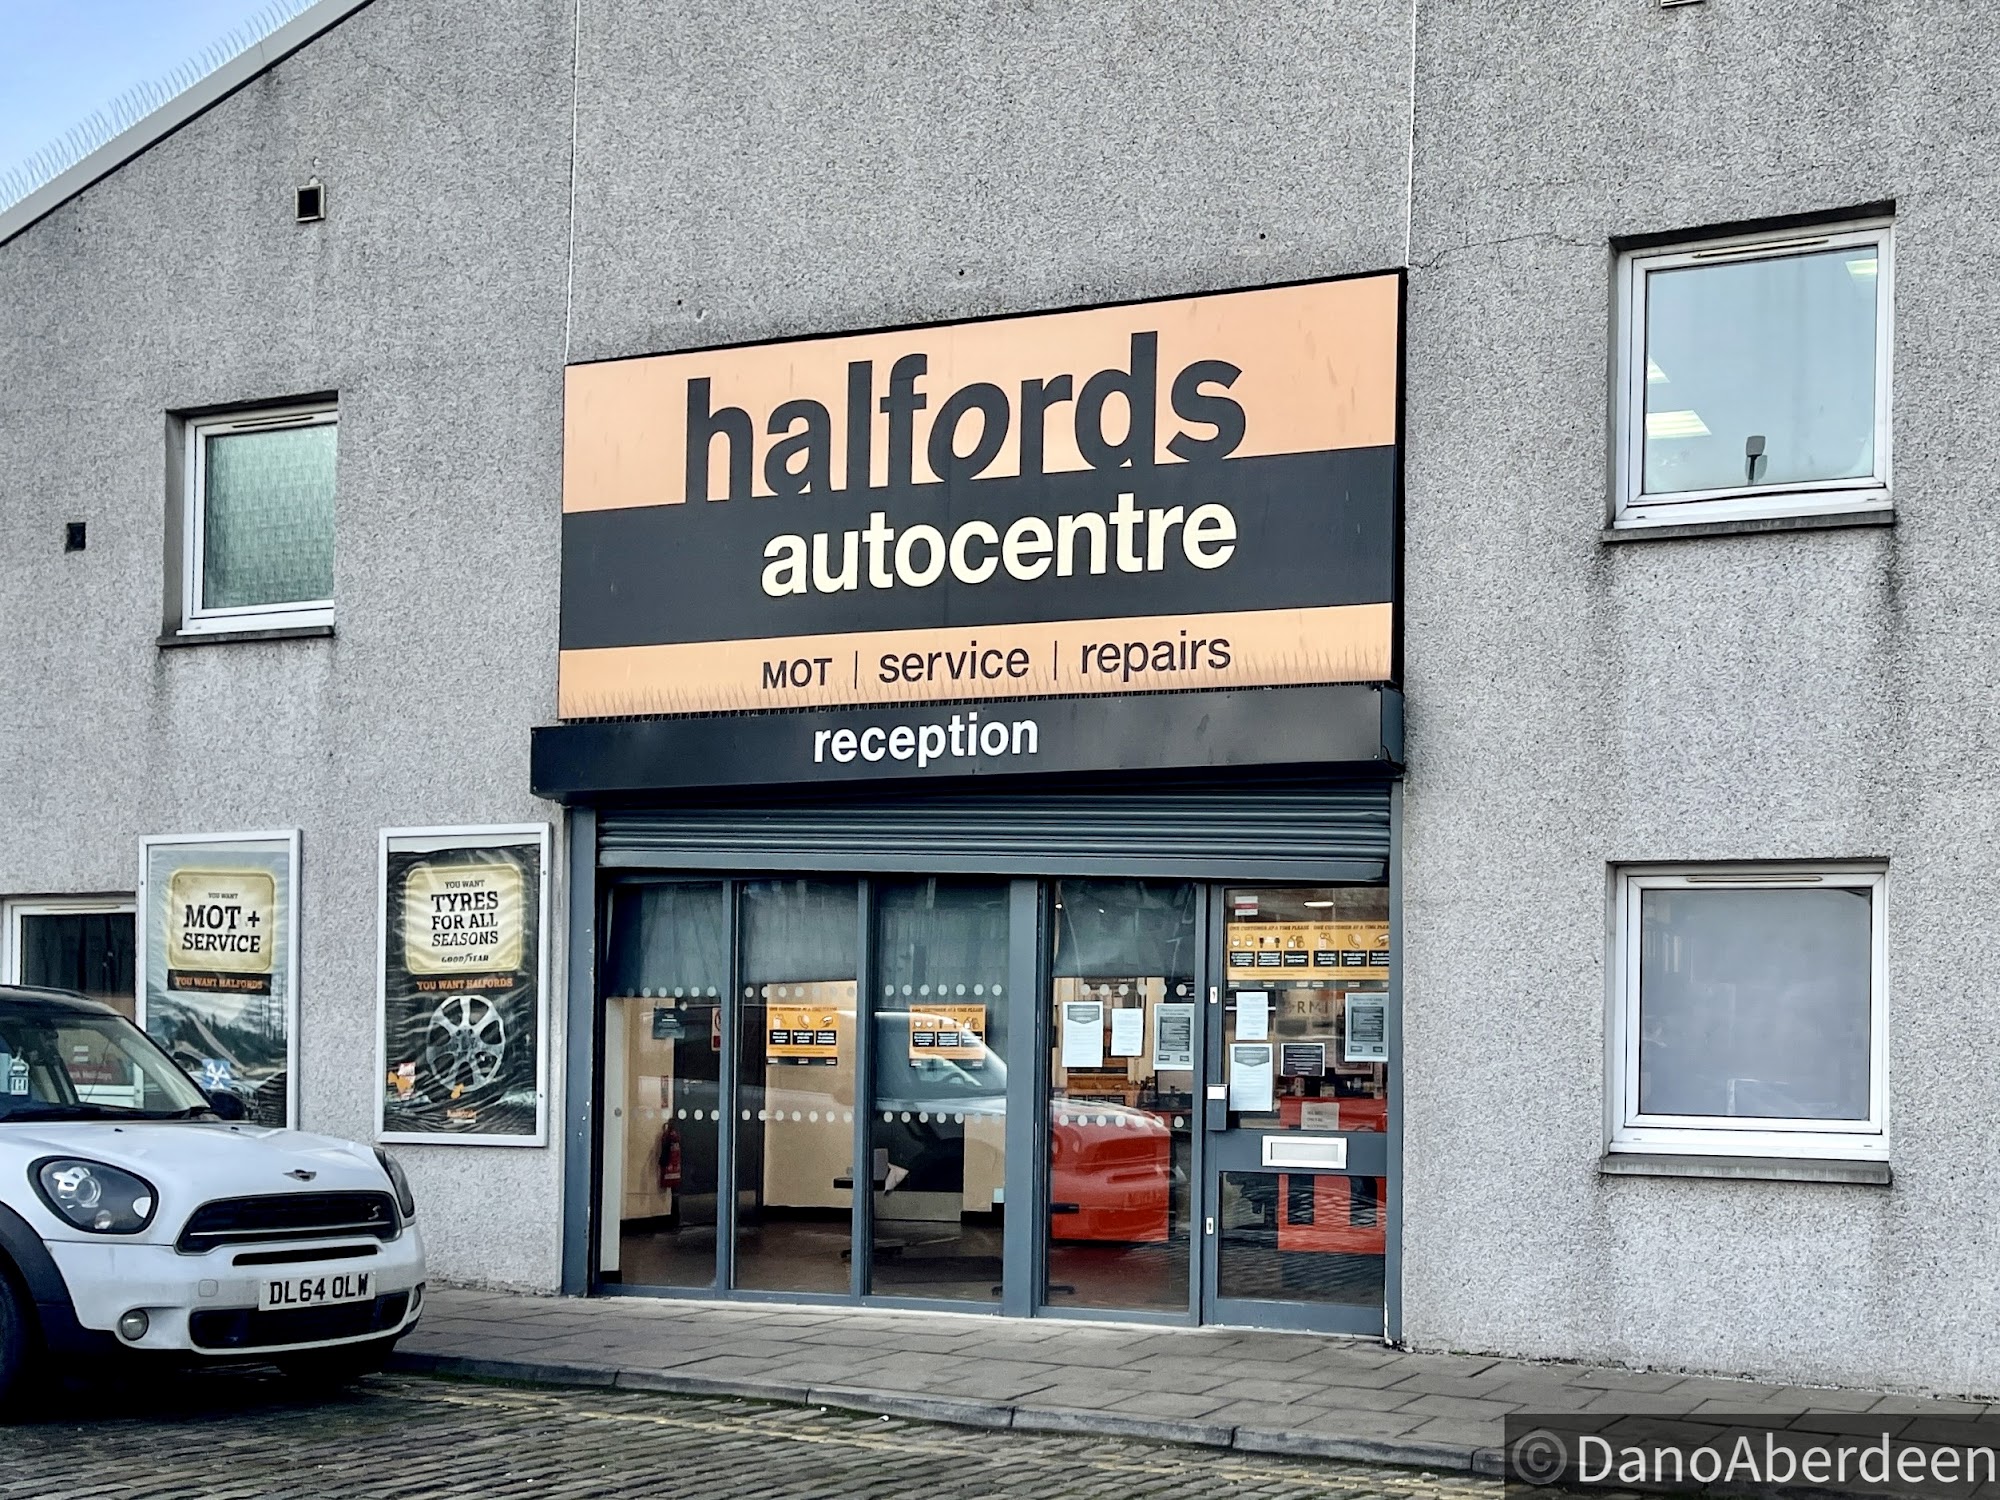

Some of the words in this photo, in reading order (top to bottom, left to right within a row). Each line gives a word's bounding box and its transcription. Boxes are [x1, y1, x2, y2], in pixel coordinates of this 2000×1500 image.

[685, 331, 1247, 503] halfords
[761, 492, 1239, 597] autocentre
[762, 656, 833, 690] MOT
[878, 641, 1030, 684] service
[1080, 630, 1232, 683] repairs
[813, 711, 1039, 768] reception
[445, 881, 460, 889] YOU
[462, 880, 485, 888] WANT
[431, 891, 499, 913] TYRES
[183, 904, 242, 929] MOT
[431, 915, 465, 930] FOR
[468, 913, 498, 929] ALL
[182, 932, 261, 953] SERVICE
[431, 931, 499, 947] SEASONS
[416, 981, 437, 991] YOU
[437, 980, 465, 990] WANT
[466, 977, 513, 988] HALFORDS
[269, 1278, 326, 1305] DL64
[332, 1272, 369, 1299] OLW
